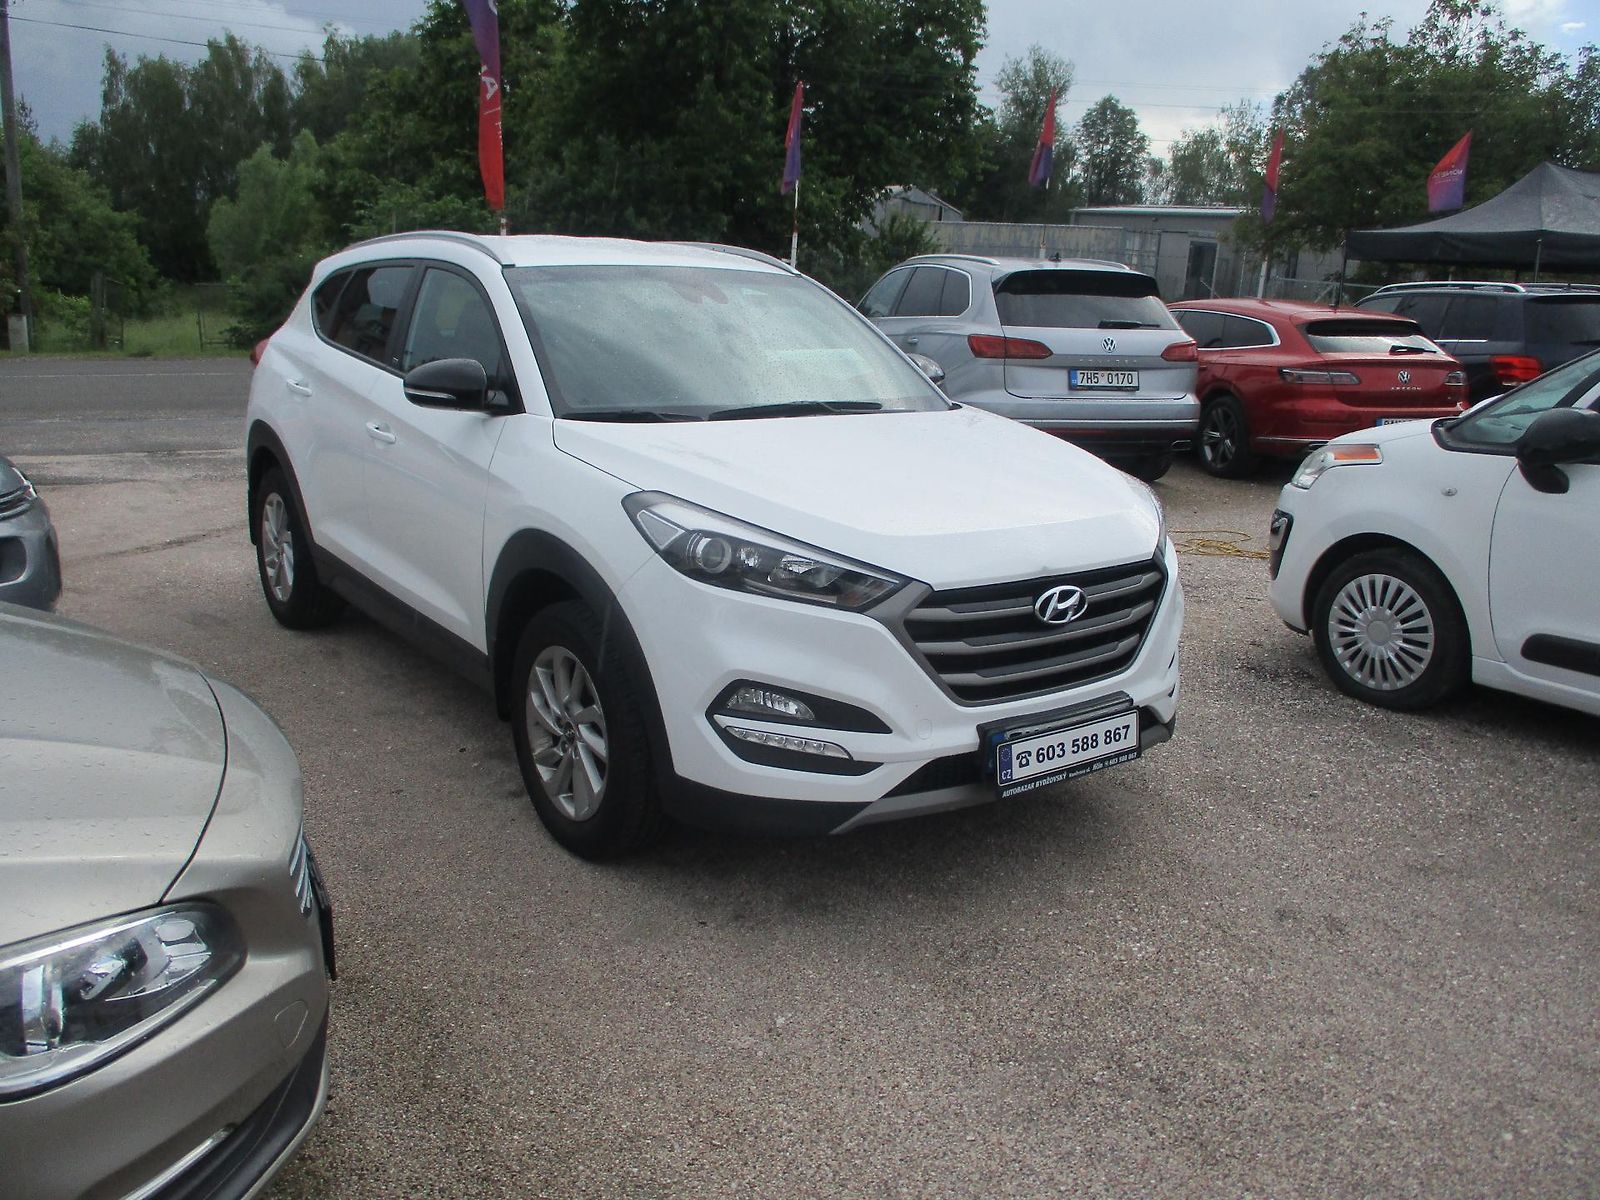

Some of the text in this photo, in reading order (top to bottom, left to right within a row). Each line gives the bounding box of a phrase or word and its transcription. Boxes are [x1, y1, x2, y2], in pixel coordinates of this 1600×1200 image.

[1079, 371, 1133, 385] 7H5 0170
[1036, 724, 1131, 763] 603 588 867
[1001, 769, 1011, 780] CZ
[1002, 782, 1035, 798] AUTOBAZAR
